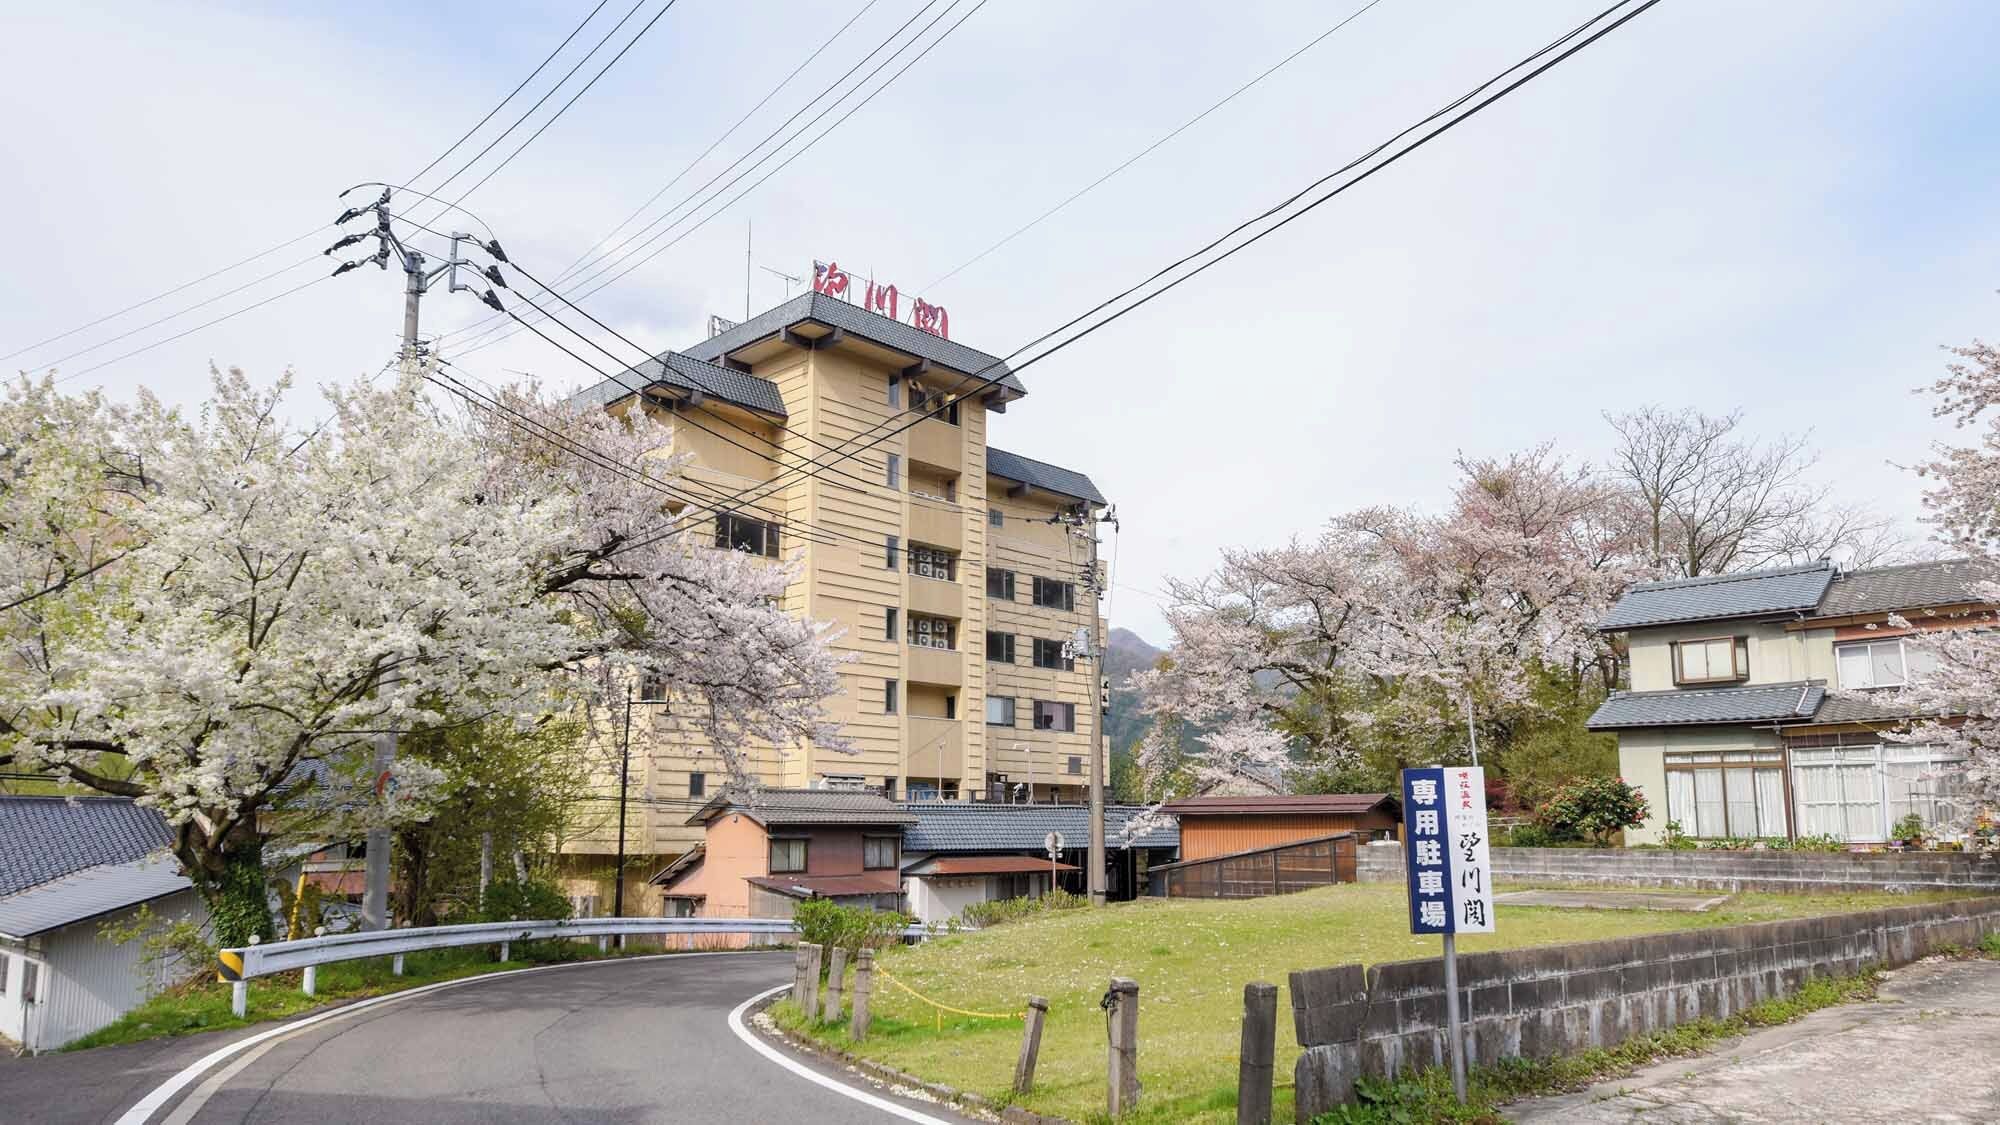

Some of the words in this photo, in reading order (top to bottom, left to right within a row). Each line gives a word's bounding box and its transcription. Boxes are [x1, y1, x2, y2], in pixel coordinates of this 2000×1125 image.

[1411, 779, 1446, 927] 専用駐車場
